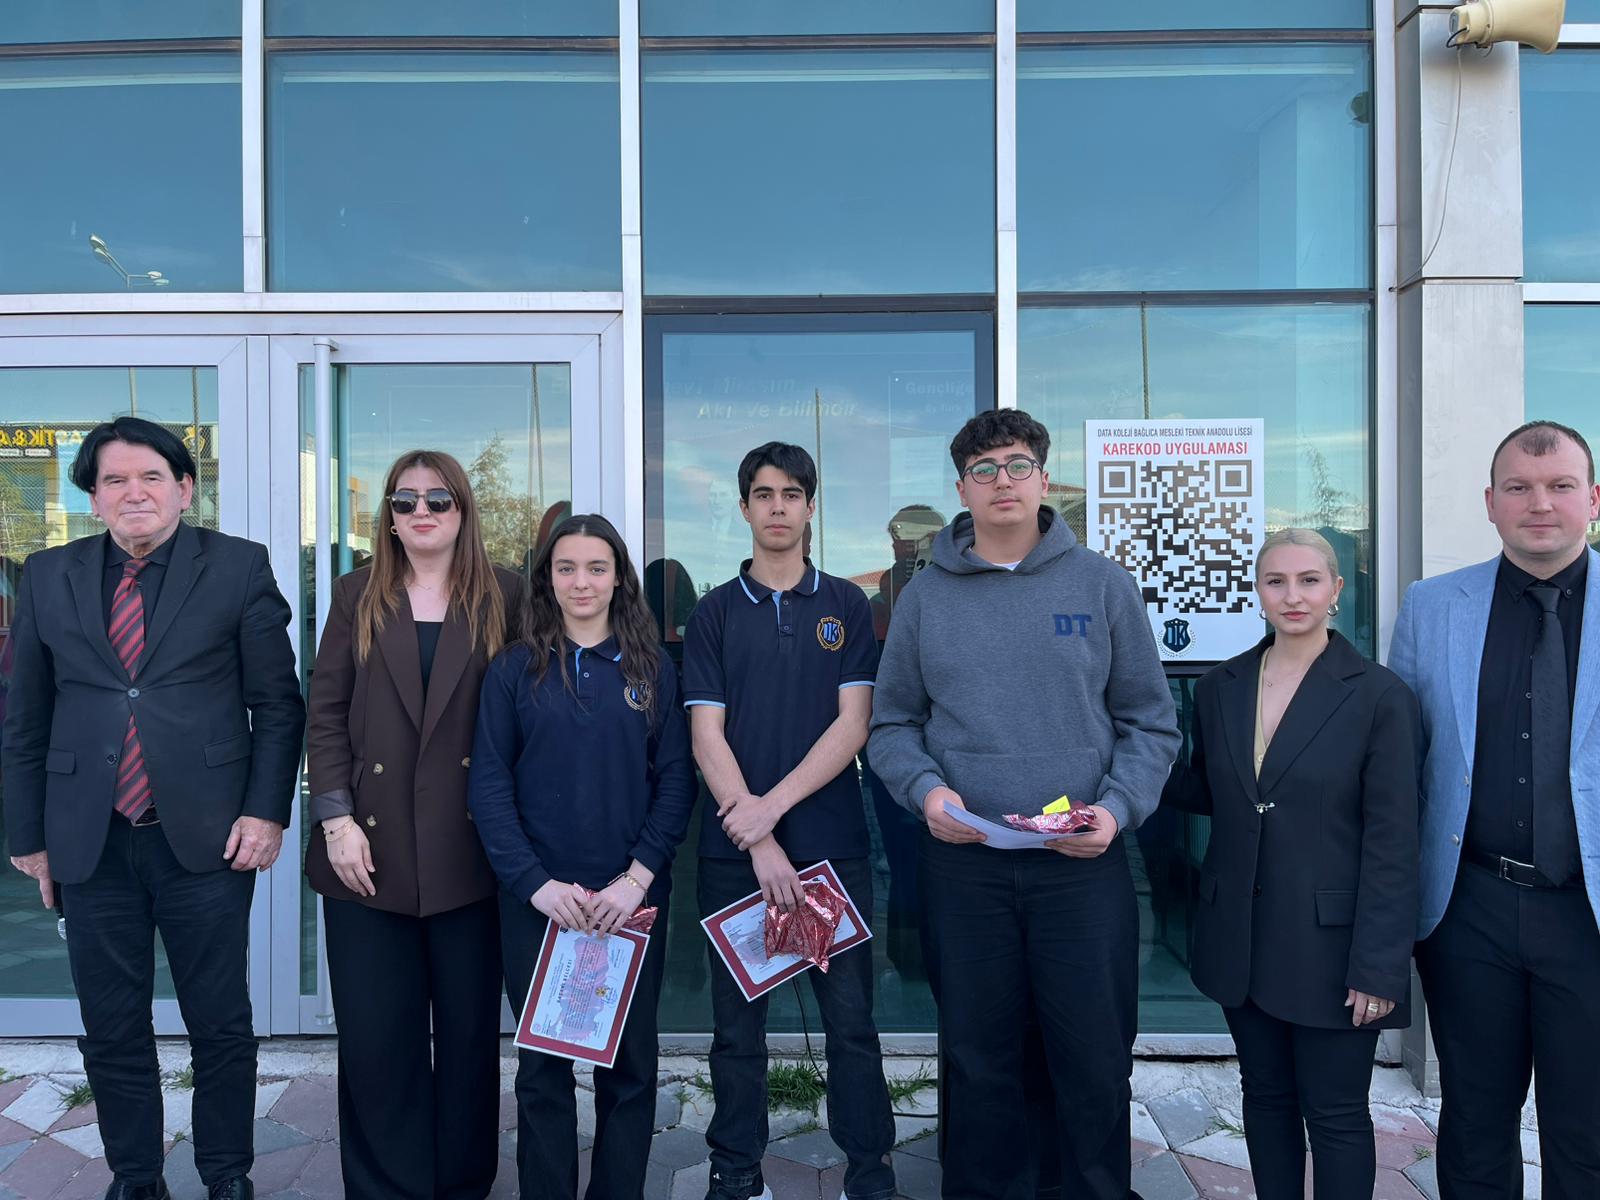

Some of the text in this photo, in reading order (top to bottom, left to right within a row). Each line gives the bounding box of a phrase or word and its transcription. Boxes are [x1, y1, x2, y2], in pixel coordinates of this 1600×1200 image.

[1097, 428, 1112, 437] DATA
[1113, 427, 1133, 437] KOLEJİ
[1134, 427, 1158, 437] BAĞLICA
[1159, 427, 1184, 437] MESLEKİ
[1206, 427, 1233, 436] ANADOLU
[1234, 425, 1253, 436] LİSESİ
[1103, 441, 1248, 456] KAREKOD UYGULAMASI
[1052, 613, 1092, 638] DT
